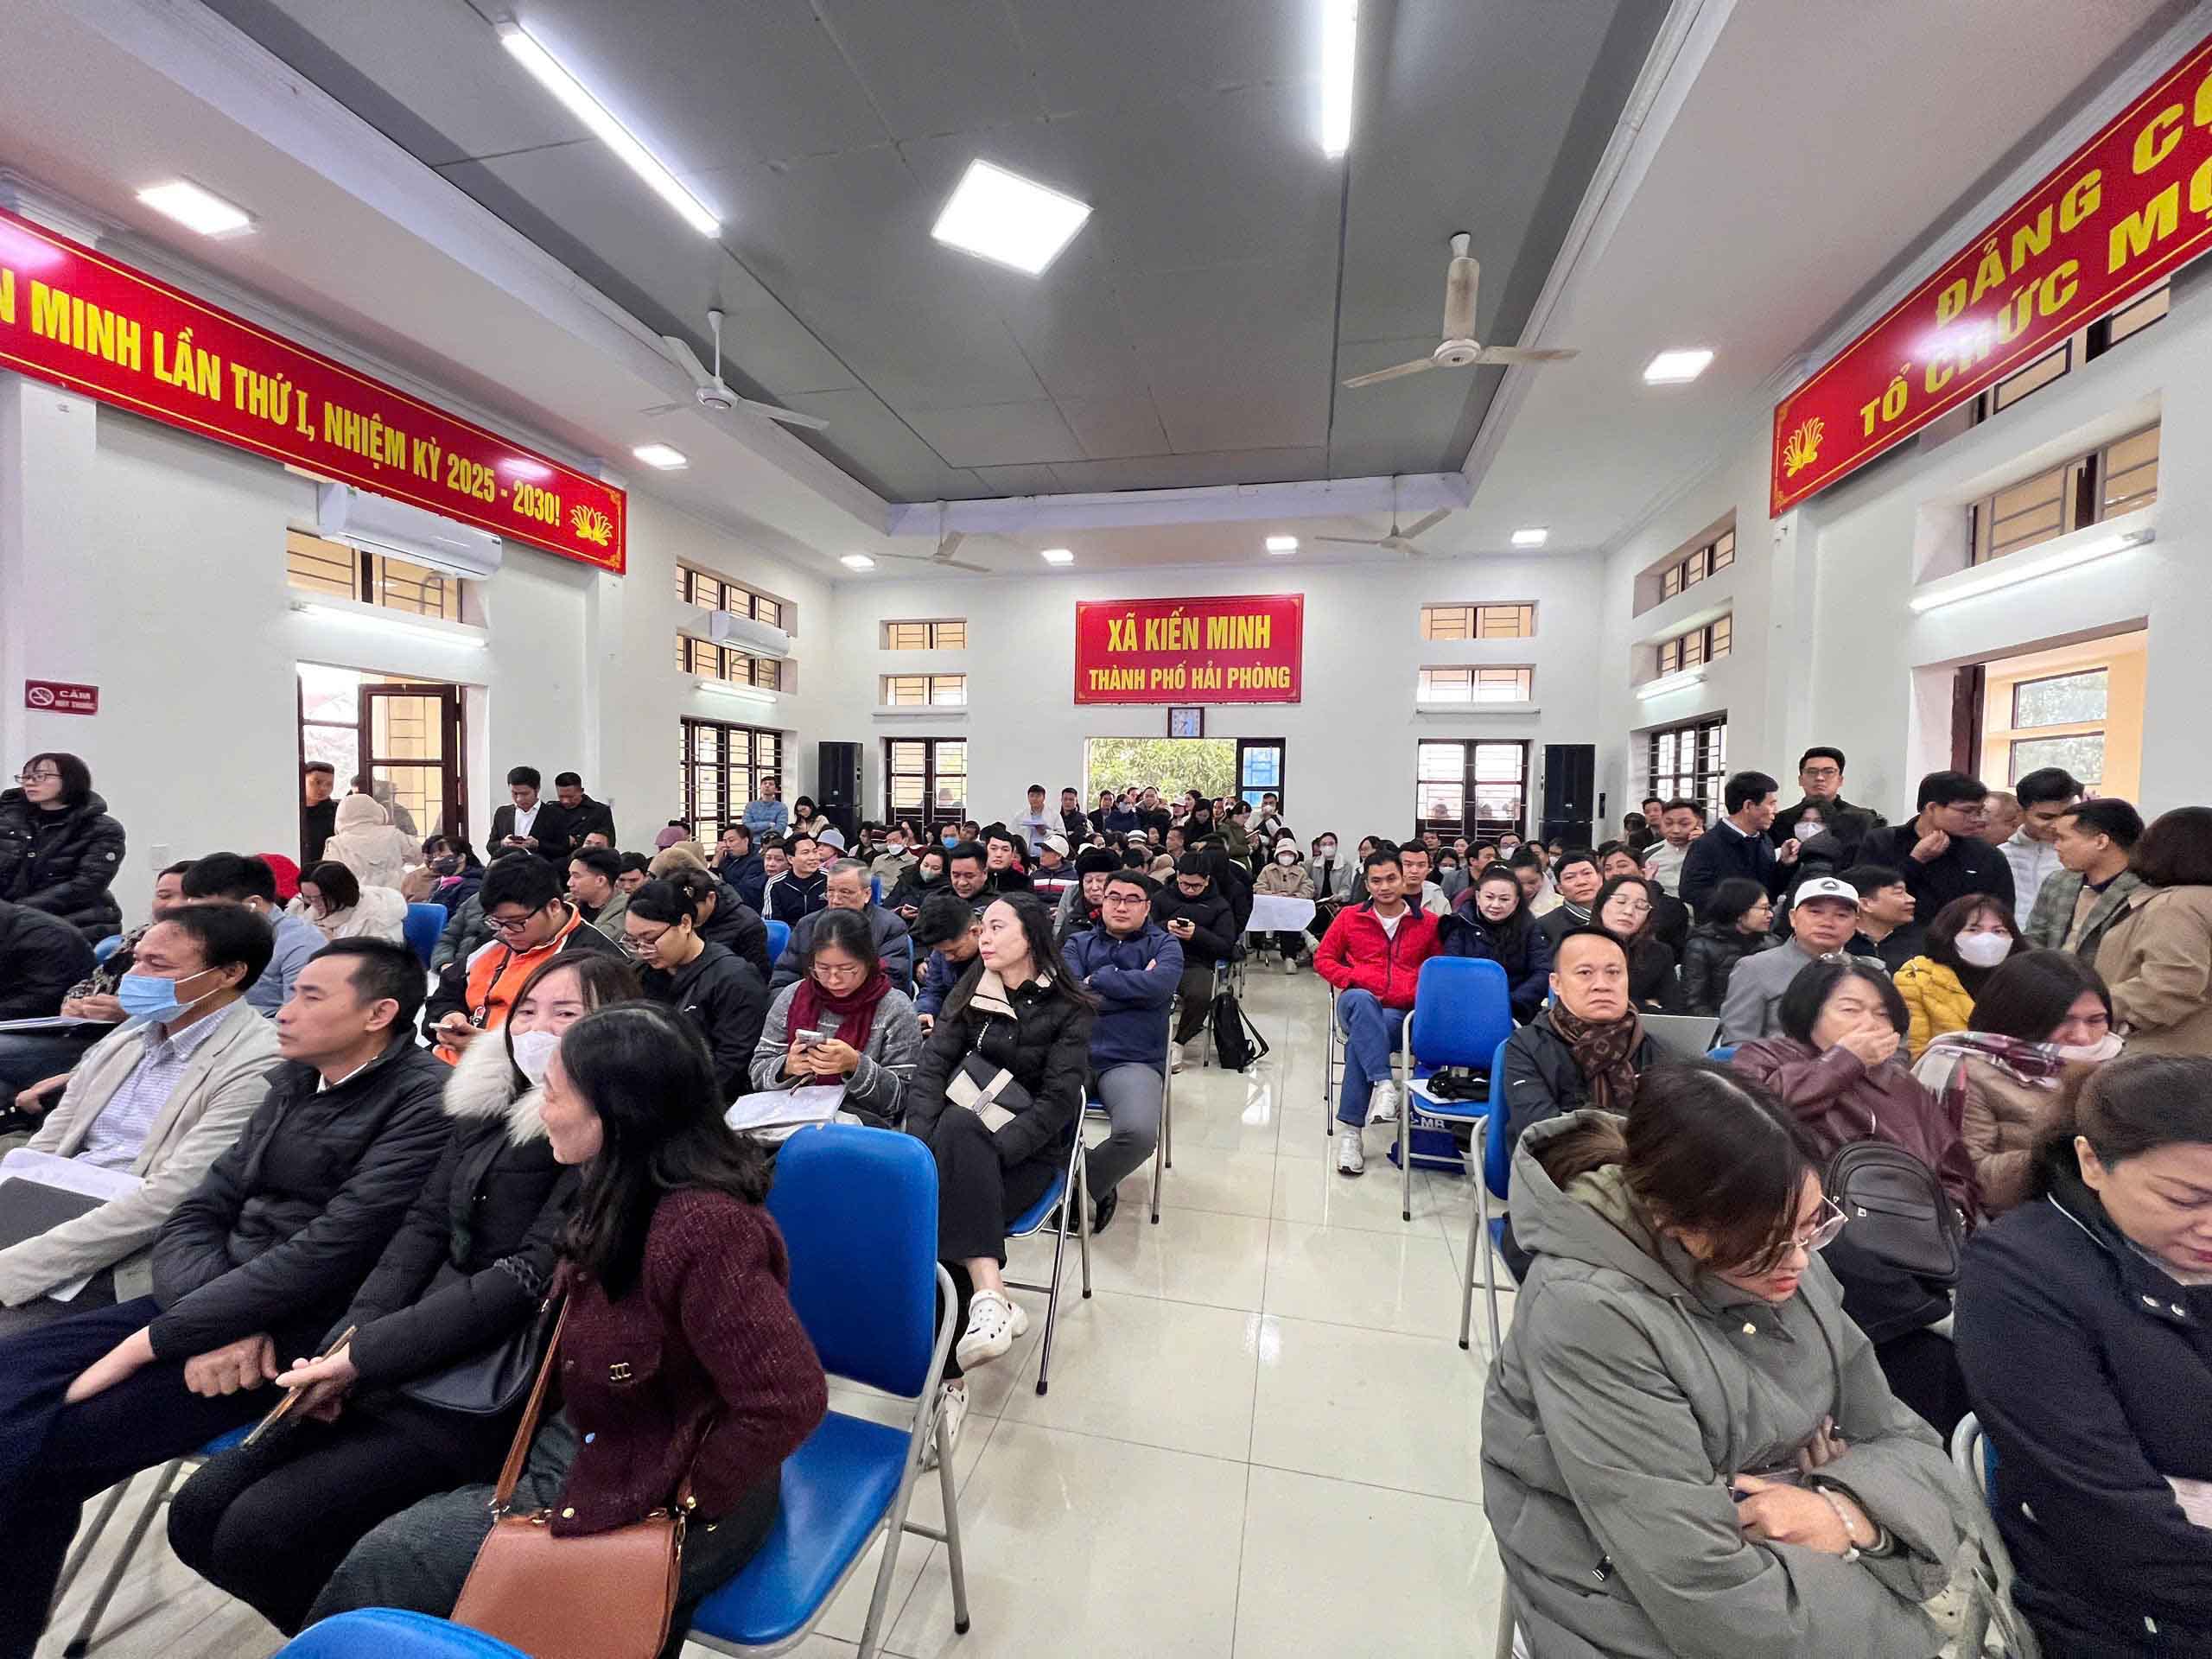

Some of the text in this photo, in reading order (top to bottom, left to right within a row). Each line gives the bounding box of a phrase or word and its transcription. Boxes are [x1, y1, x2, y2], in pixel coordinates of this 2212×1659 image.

[1936, 168, 2101, 330] ĐẢNG
[30, 280, 141, 372] MINH
[153, 327, 221, 401] LẦN
[231, 362, 292, 425] THỨ
[296, 390, 315, 442] I,
[324, 401, 406, 470] NHIỆM
[413, 436, 442, 482] KỲ
[447, 453, 495, 503] 2025
[513, 480, 561, 526] 2030!
[1860, 362, 1911, 436] TỔ
[1107, 607, 1271, 652] XÃ KIẾN MINH
[1089, 660, 1291, 690] THÀNH PHỐ HẢI PHÒNG
